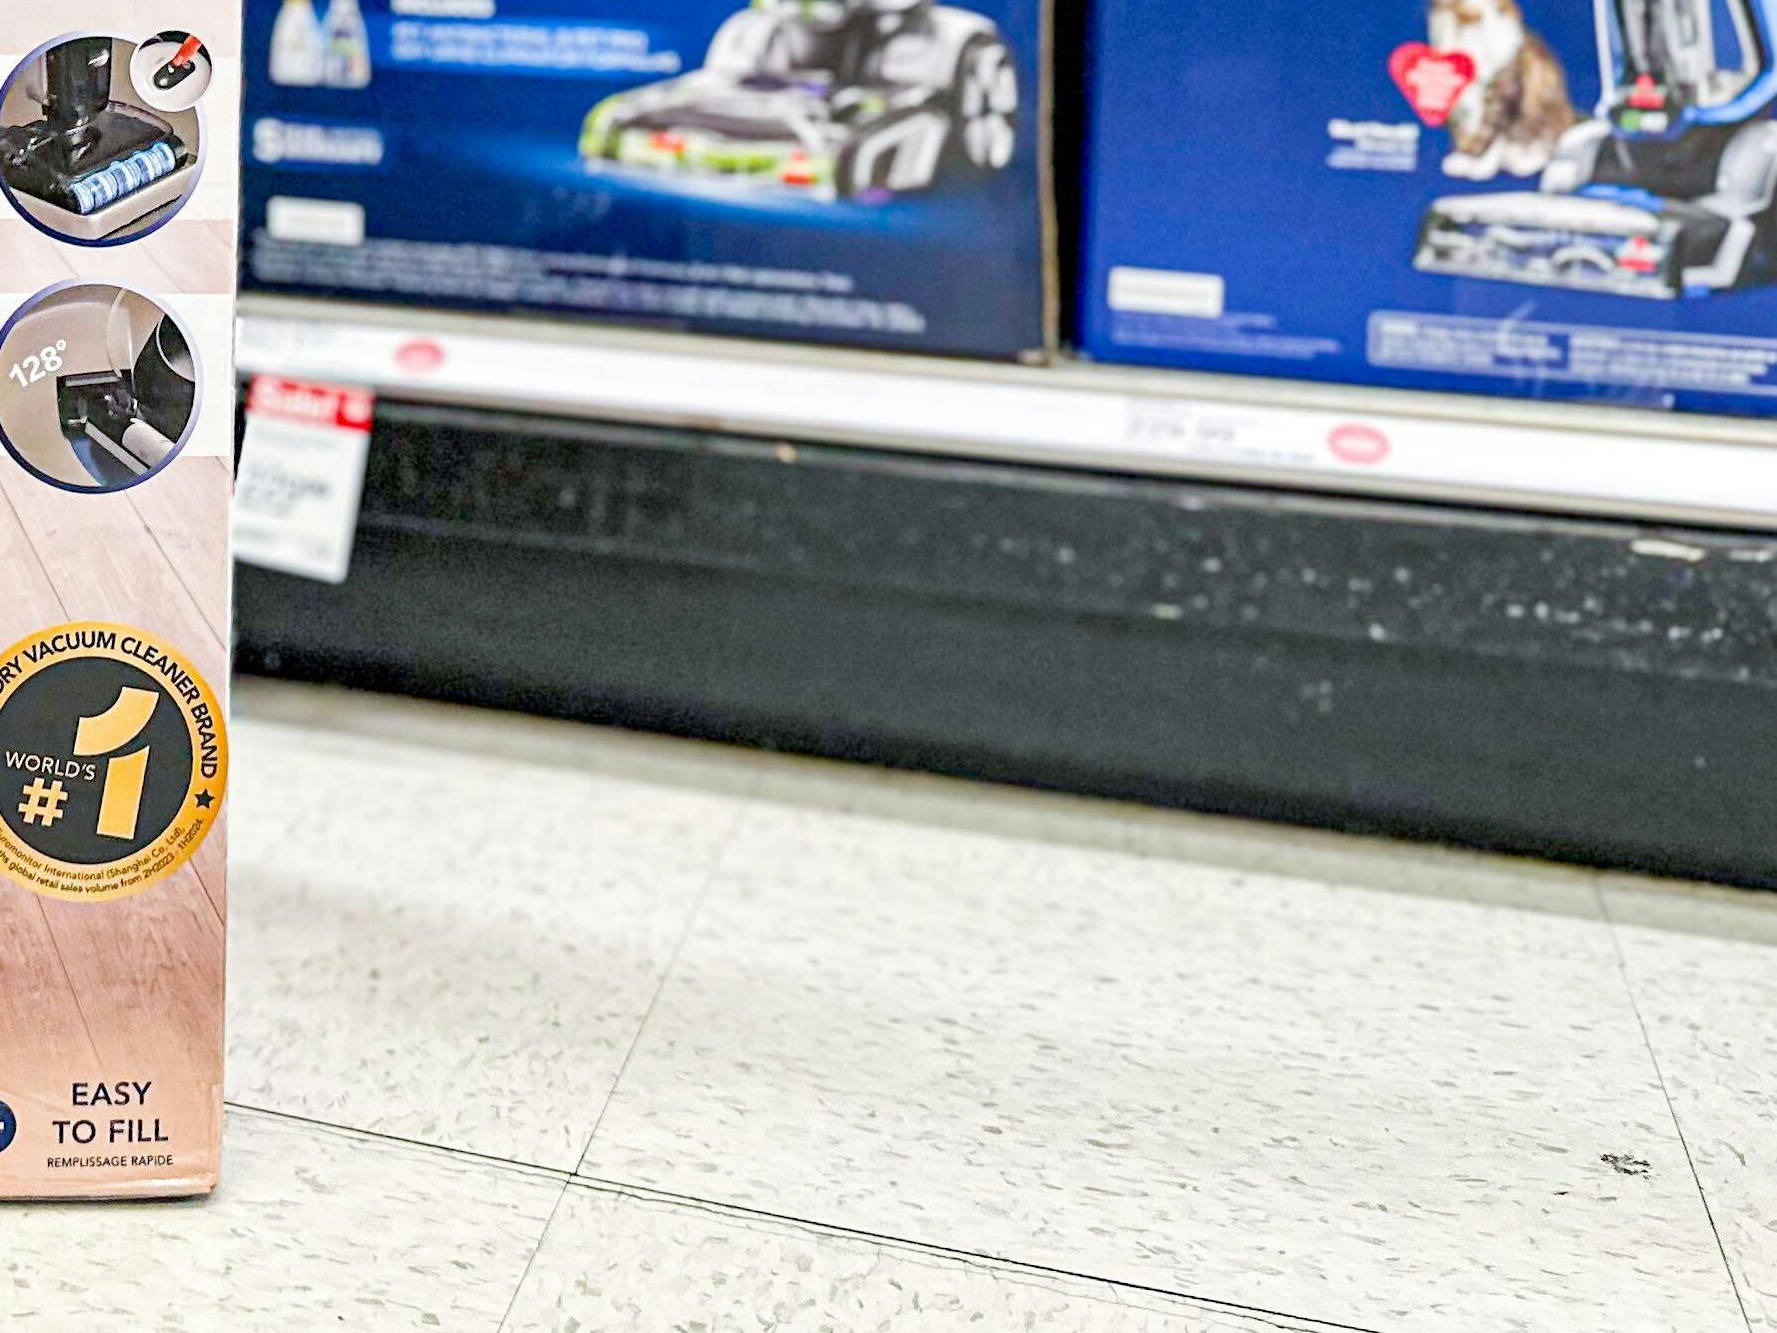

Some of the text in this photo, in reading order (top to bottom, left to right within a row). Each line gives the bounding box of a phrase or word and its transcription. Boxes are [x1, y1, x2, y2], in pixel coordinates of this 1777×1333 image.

[21, 629, 117, 665] VACUUM
[120, 635, 202, 706] CLEANER
[189, 695, 219, 780] BRAND
[4, 750, 97, 782] WORLD'S
[72, 685, 160, 841] 1
[71, 1080, 153, 1107] EASY
[51, 1118, 170, 1145] TO FILL
[47, 1153, 174, 1169] REMPLISSAGE RAPIDE
